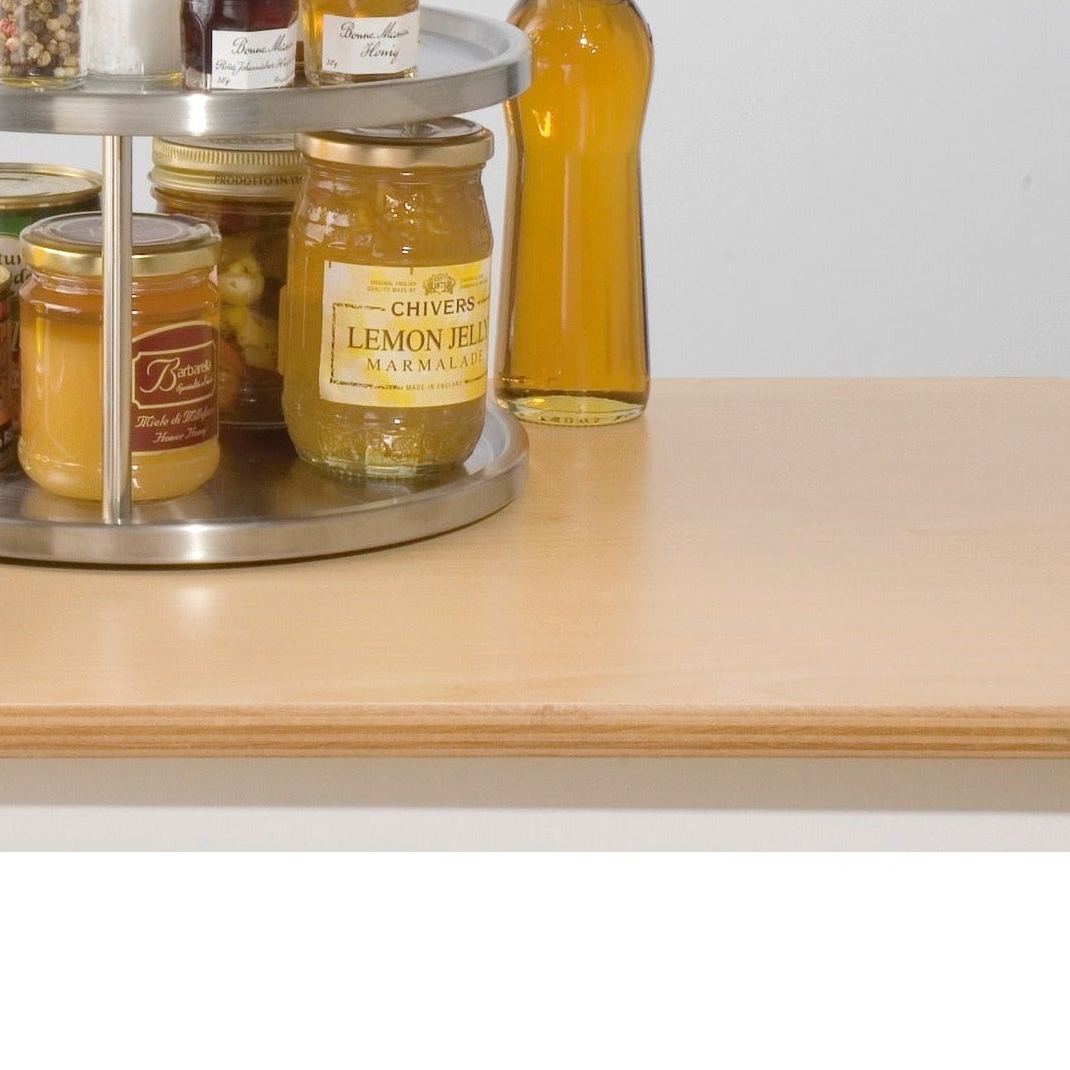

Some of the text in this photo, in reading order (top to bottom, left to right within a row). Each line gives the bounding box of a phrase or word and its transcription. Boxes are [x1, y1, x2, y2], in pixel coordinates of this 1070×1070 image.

[340, 21, 375, 39] Bonne
[231, 36, 267, 54] Bonne
[361, 41, 399, 64] Honig
[214, 175, 272, 186] PRODOTTO
[391, 296, 475, 317] CHIVERS
[347, 326, 443, 352] LEMON
[367, 350, 483, 372] MARMALADE
[135, 414, 169, 428] Miele
[171, 413, 181, 425] di
